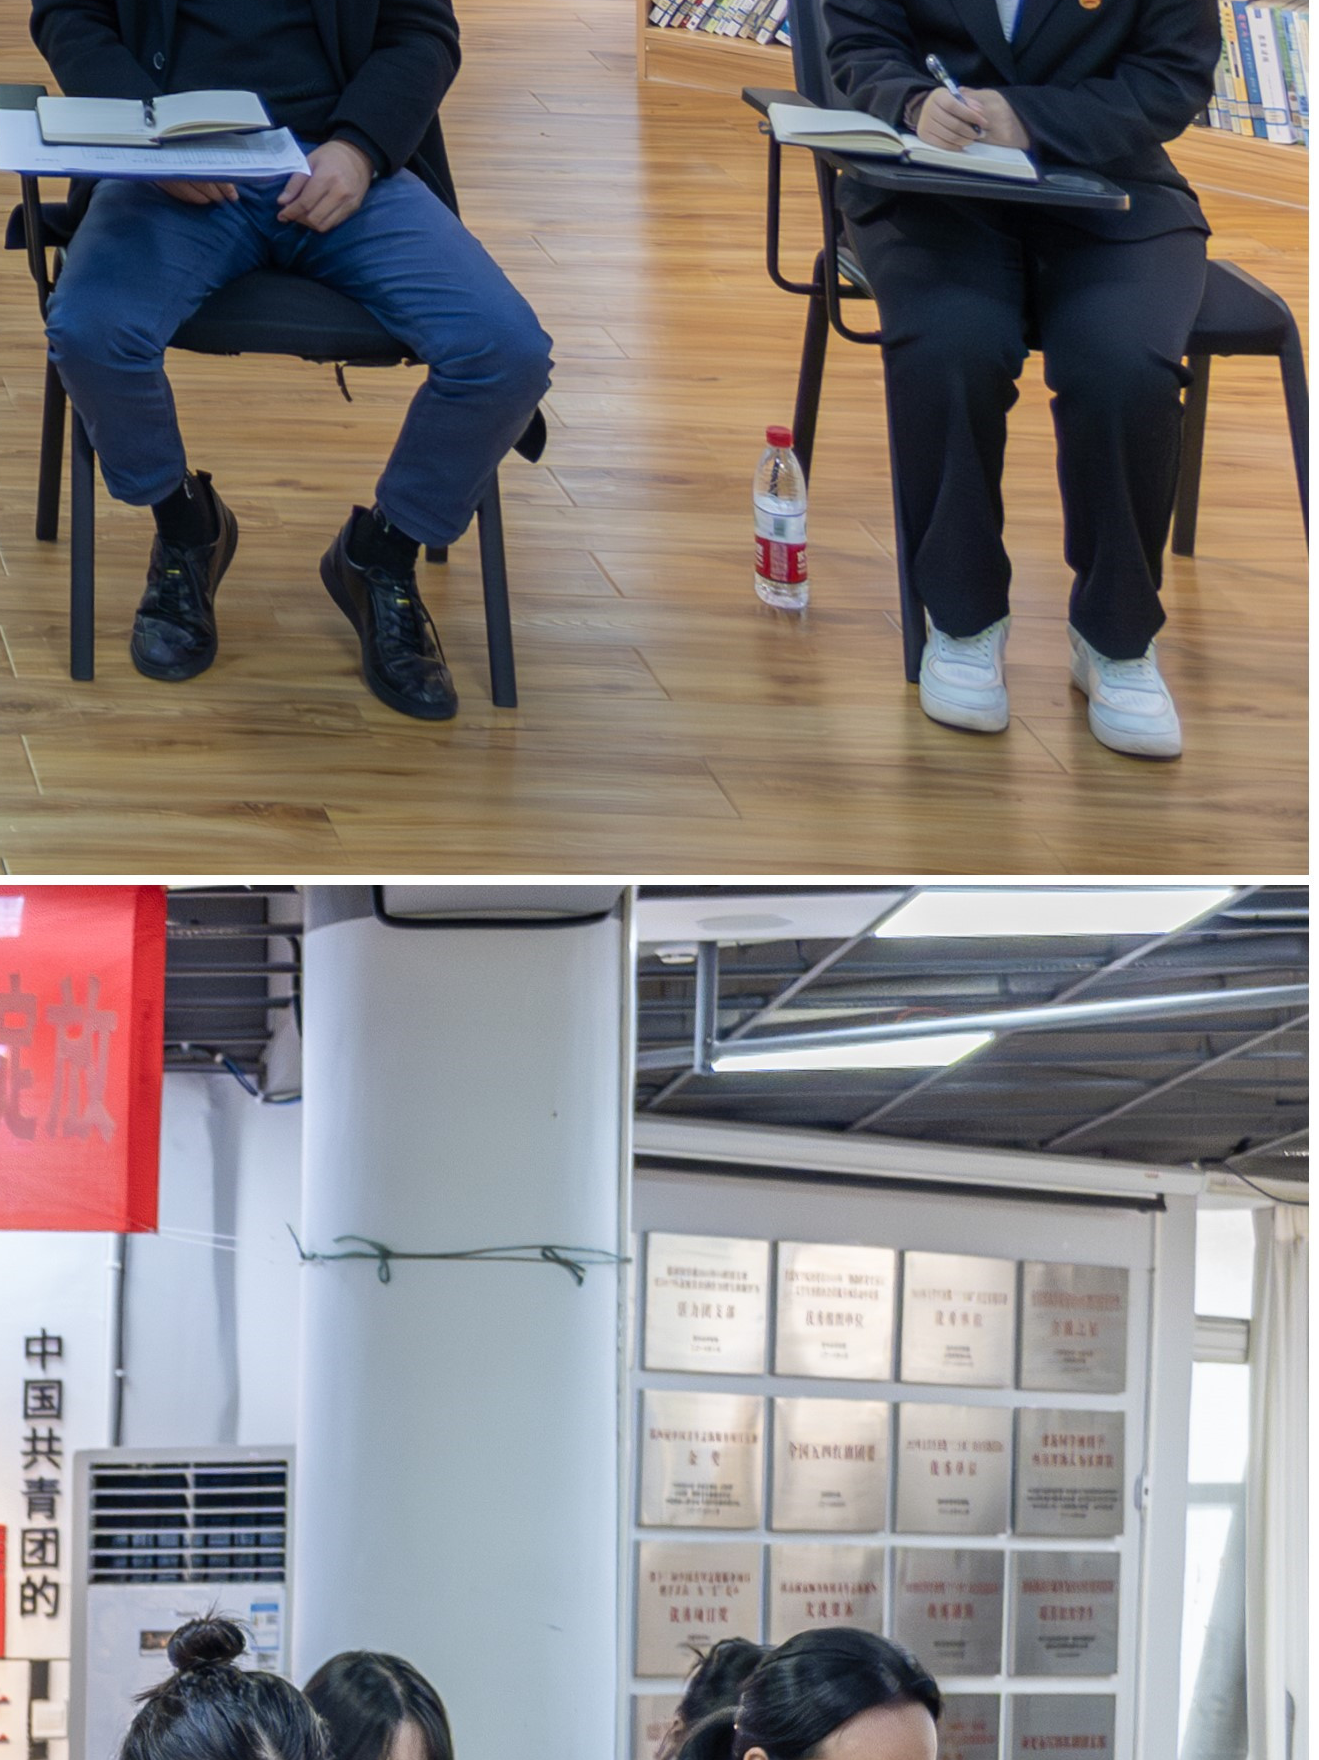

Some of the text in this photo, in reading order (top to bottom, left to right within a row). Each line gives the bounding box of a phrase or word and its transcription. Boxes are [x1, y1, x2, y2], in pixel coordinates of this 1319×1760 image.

[19, 1329, 64, 1619] 中国共青团的
